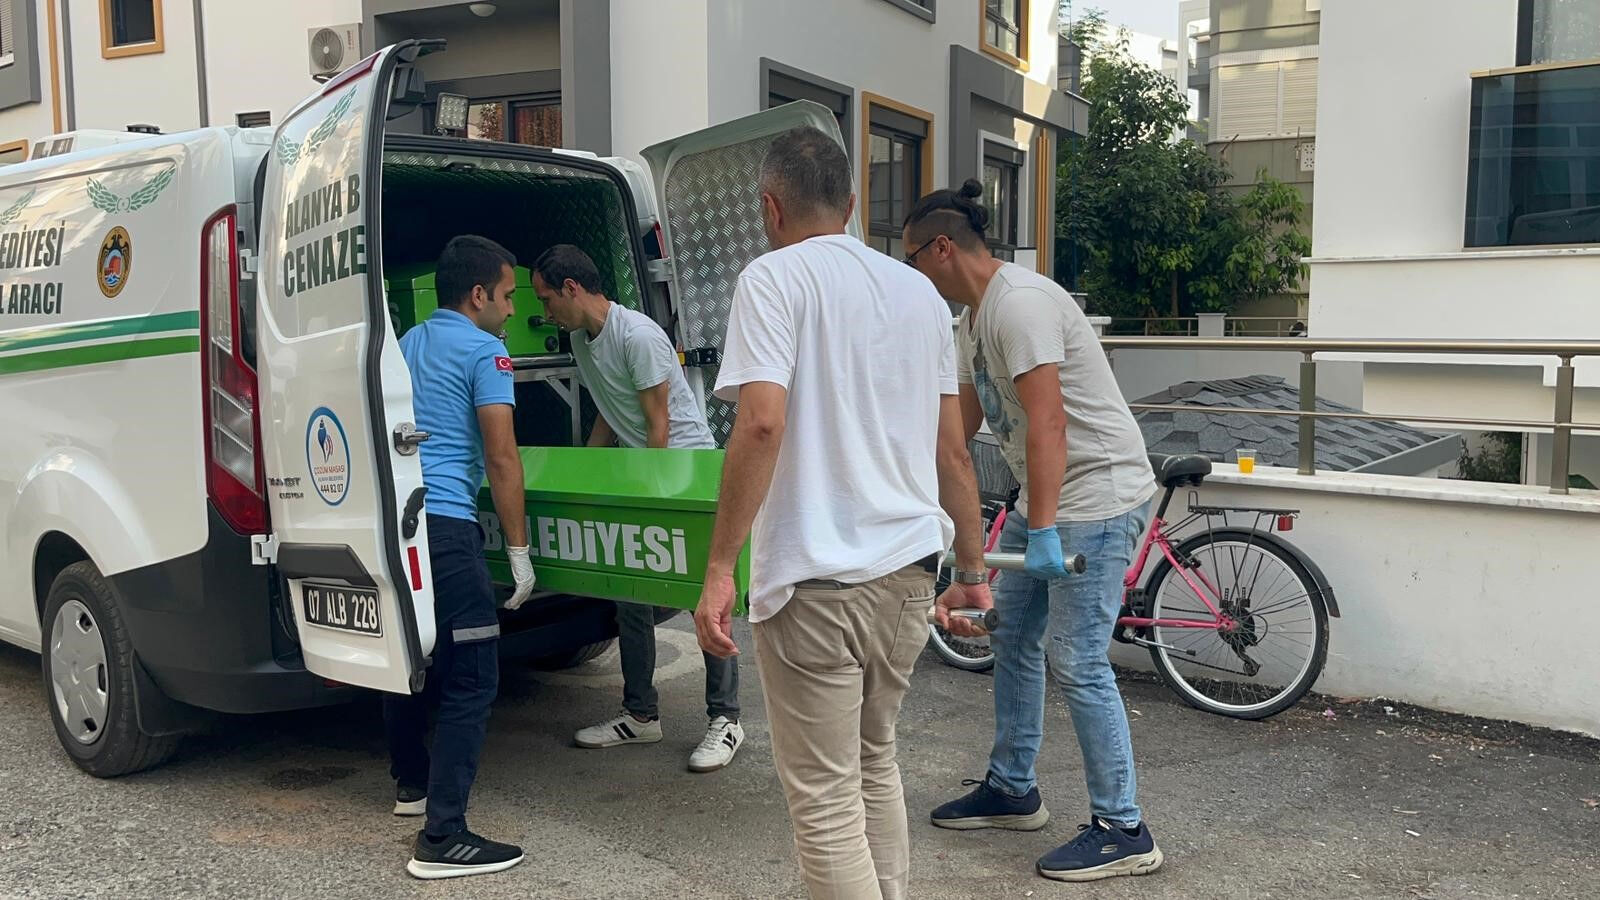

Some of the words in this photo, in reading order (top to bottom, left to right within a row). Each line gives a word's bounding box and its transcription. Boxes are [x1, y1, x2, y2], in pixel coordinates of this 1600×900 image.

[285, 180, 343, 240] ALANYA
[284, 225, 367, 297] CENAZE
[8, 282, 63, 314] ARACI
[479, 511, 688, 575] BLEDİYESİ
[308, 589, 319, 621] 07
[326, 591, 347, 625] ALB
[351, 594, 378, 630] 228
